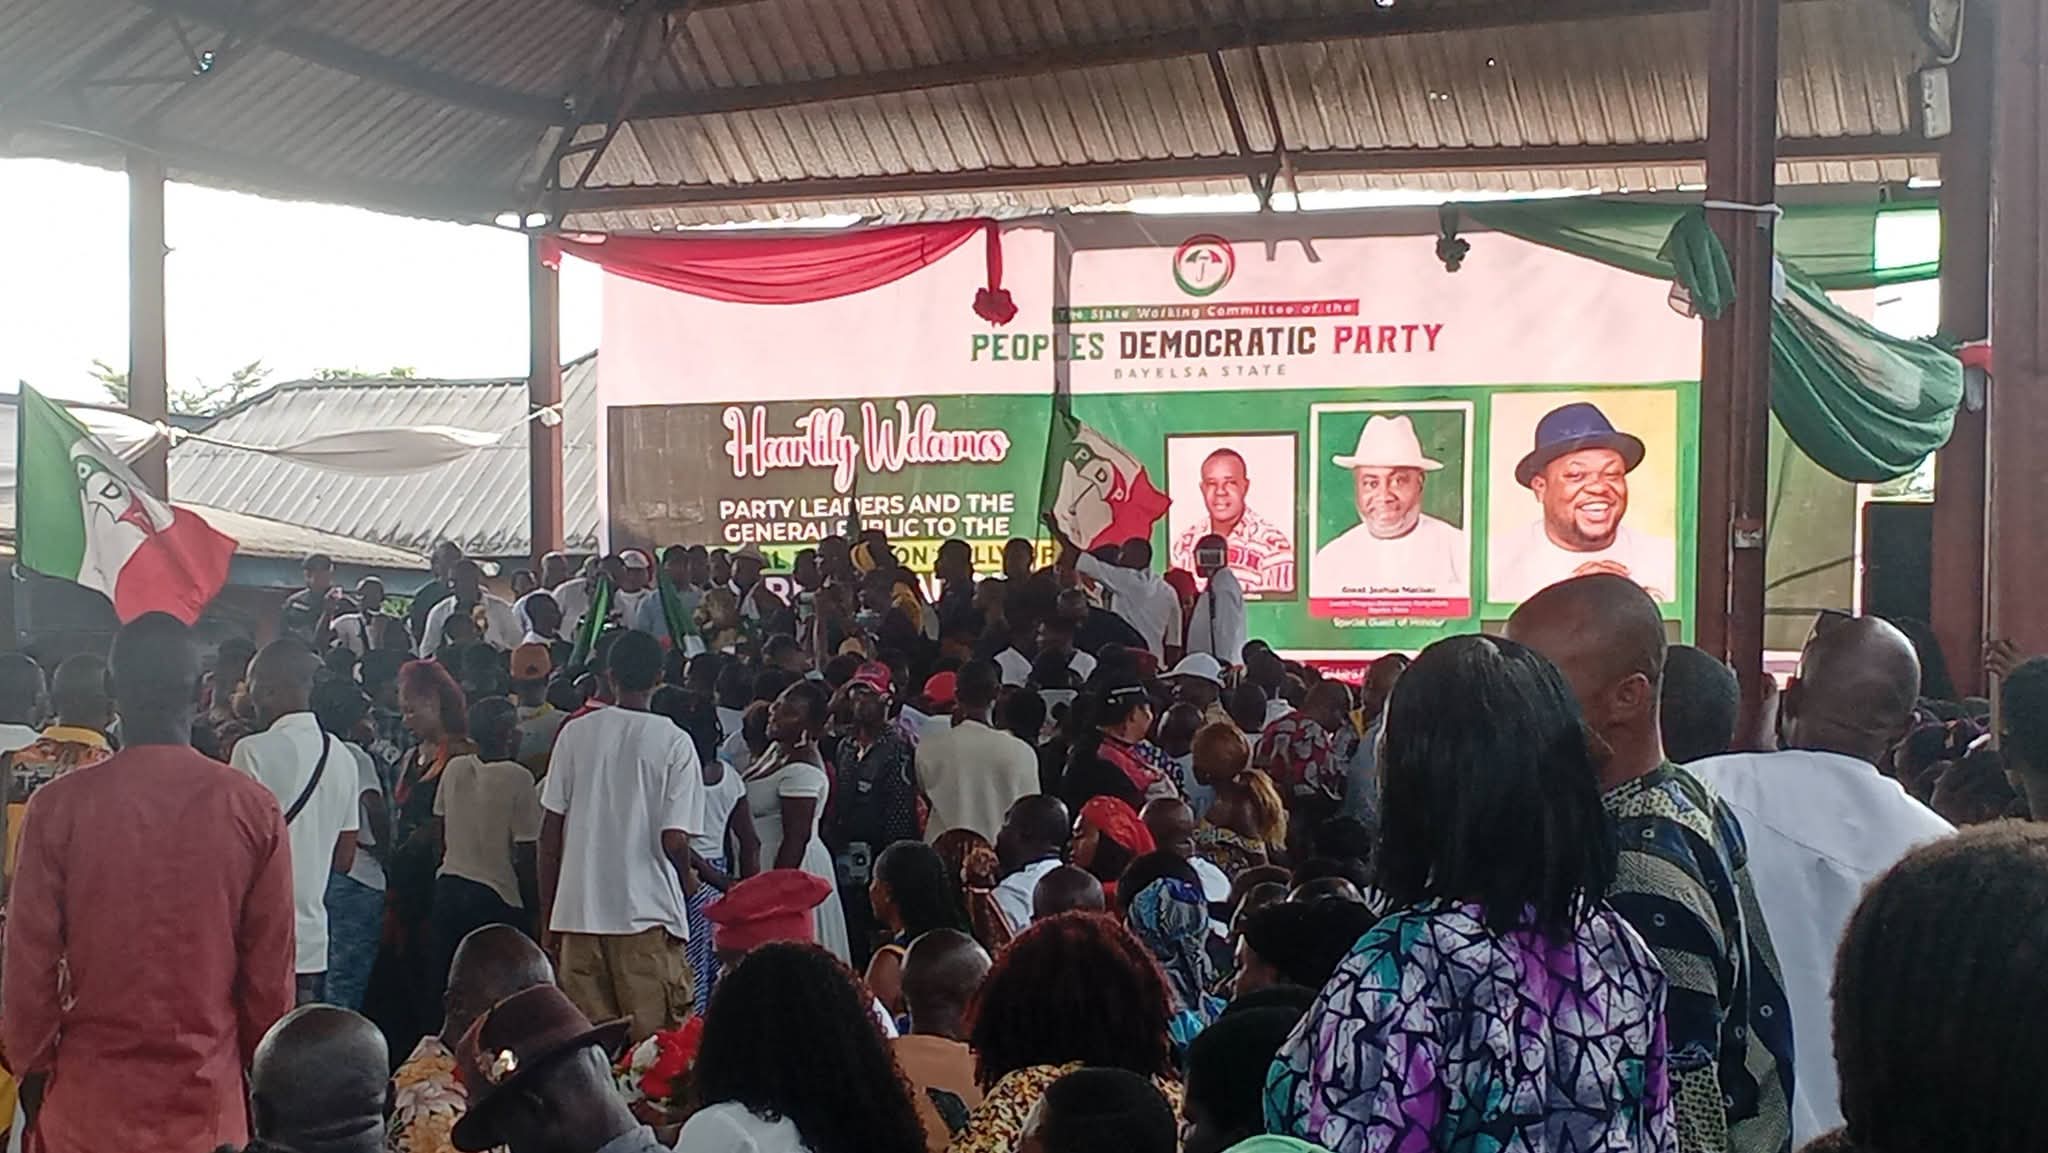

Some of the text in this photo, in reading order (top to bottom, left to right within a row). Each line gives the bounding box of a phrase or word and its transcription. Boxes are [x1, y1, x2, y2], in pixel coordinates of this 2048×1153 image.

[1089, 306, 1130, 320] State
[1136, 306, 1200, 320] Working
[1206, 304, 1295, 318] Committee
[1301, 302, 1318, 314] of
[1325, 302, 1353, 314] the
[1119, 326, 1317, 360] DEMOCRATIC
[1332, 322, 1445, 354] PARTY
[1114, 364, 1287, 380] BAYELSA STATE
[722, 404, 860, 493] Heartily
[719, 499, 794, 520] PARTY
[907, 494, 962, 514] AND
[966, 493, 1015, 513] THE
[924, 517, 957, 537] TO
[962, 516, 1010, 536] THE
